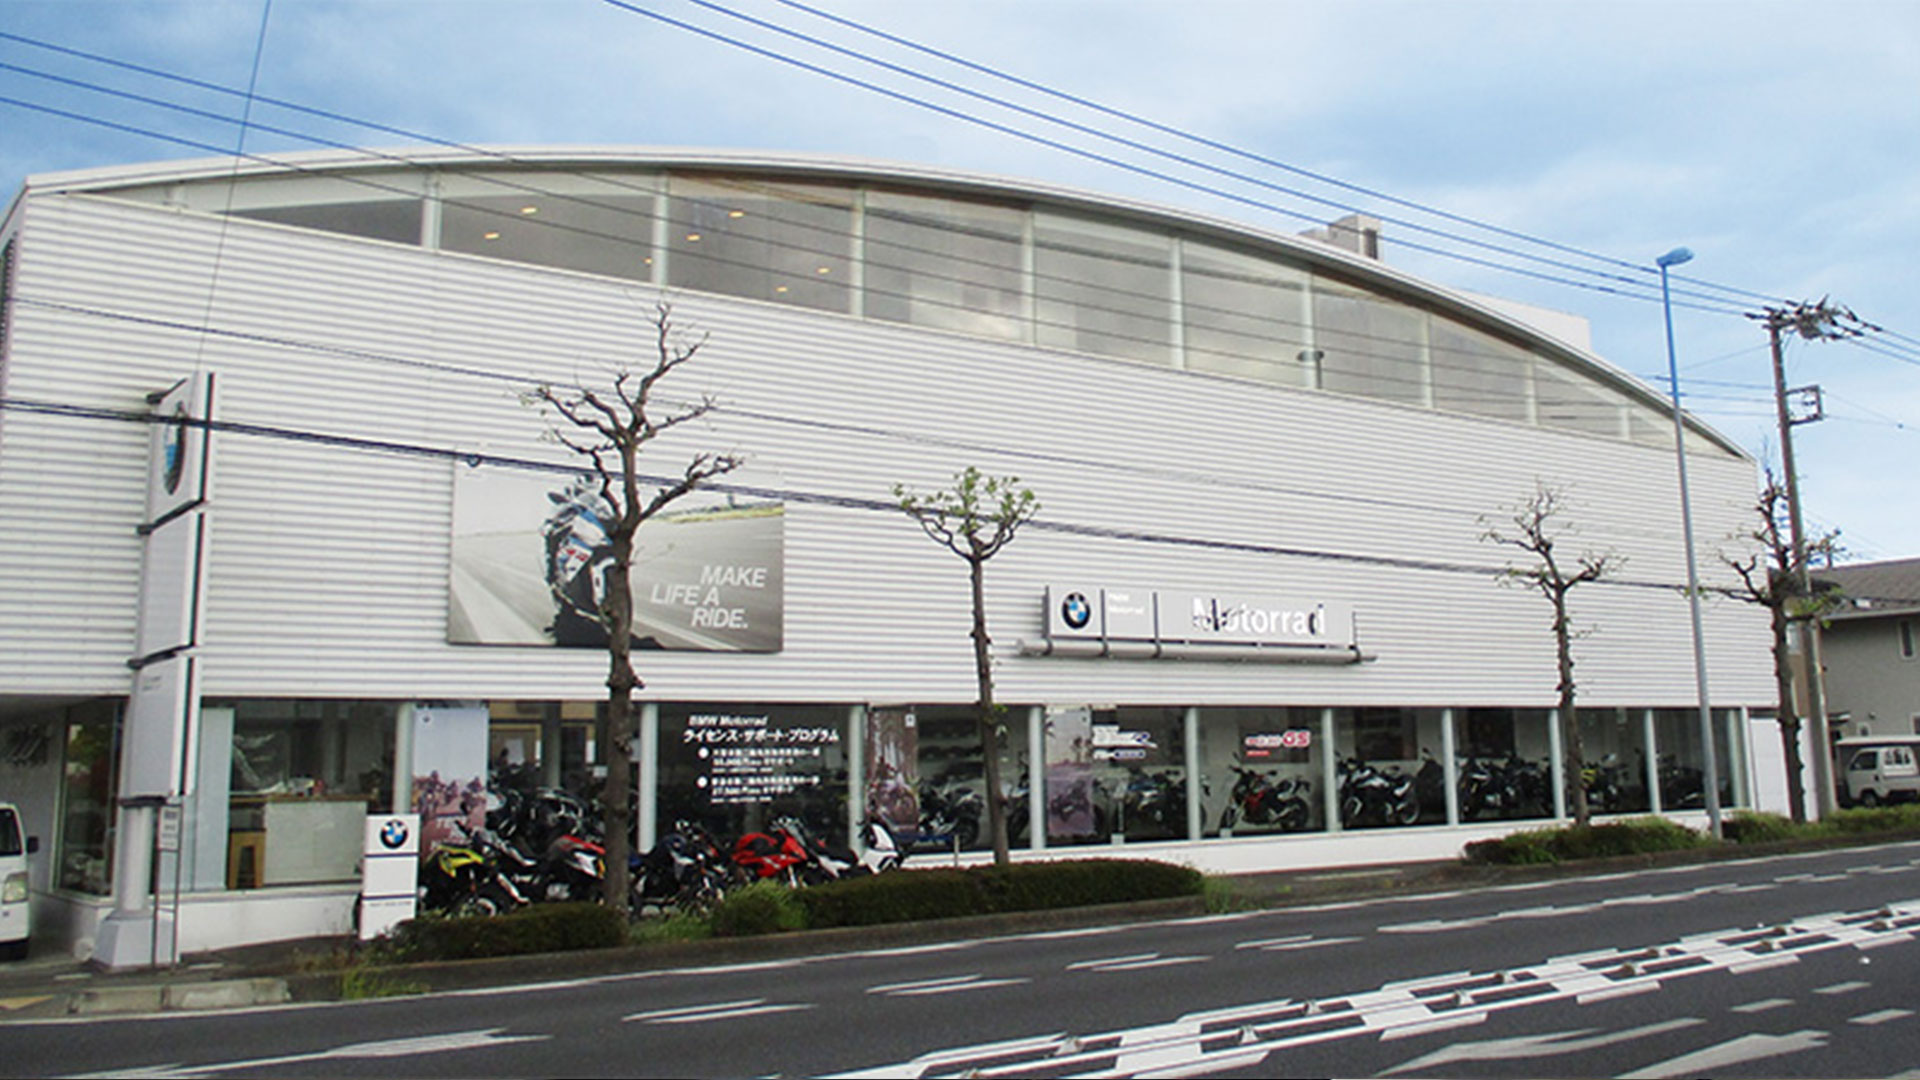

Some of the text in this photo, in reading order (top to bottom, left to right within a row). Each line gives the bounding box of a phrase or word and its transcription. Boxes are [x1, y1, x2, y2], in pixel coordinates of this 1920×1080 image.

[701, 565, 767, 588] MAKE
[650, 584, 720, 606] LIFE A
[691, 607, 748, 629] RIDE.
